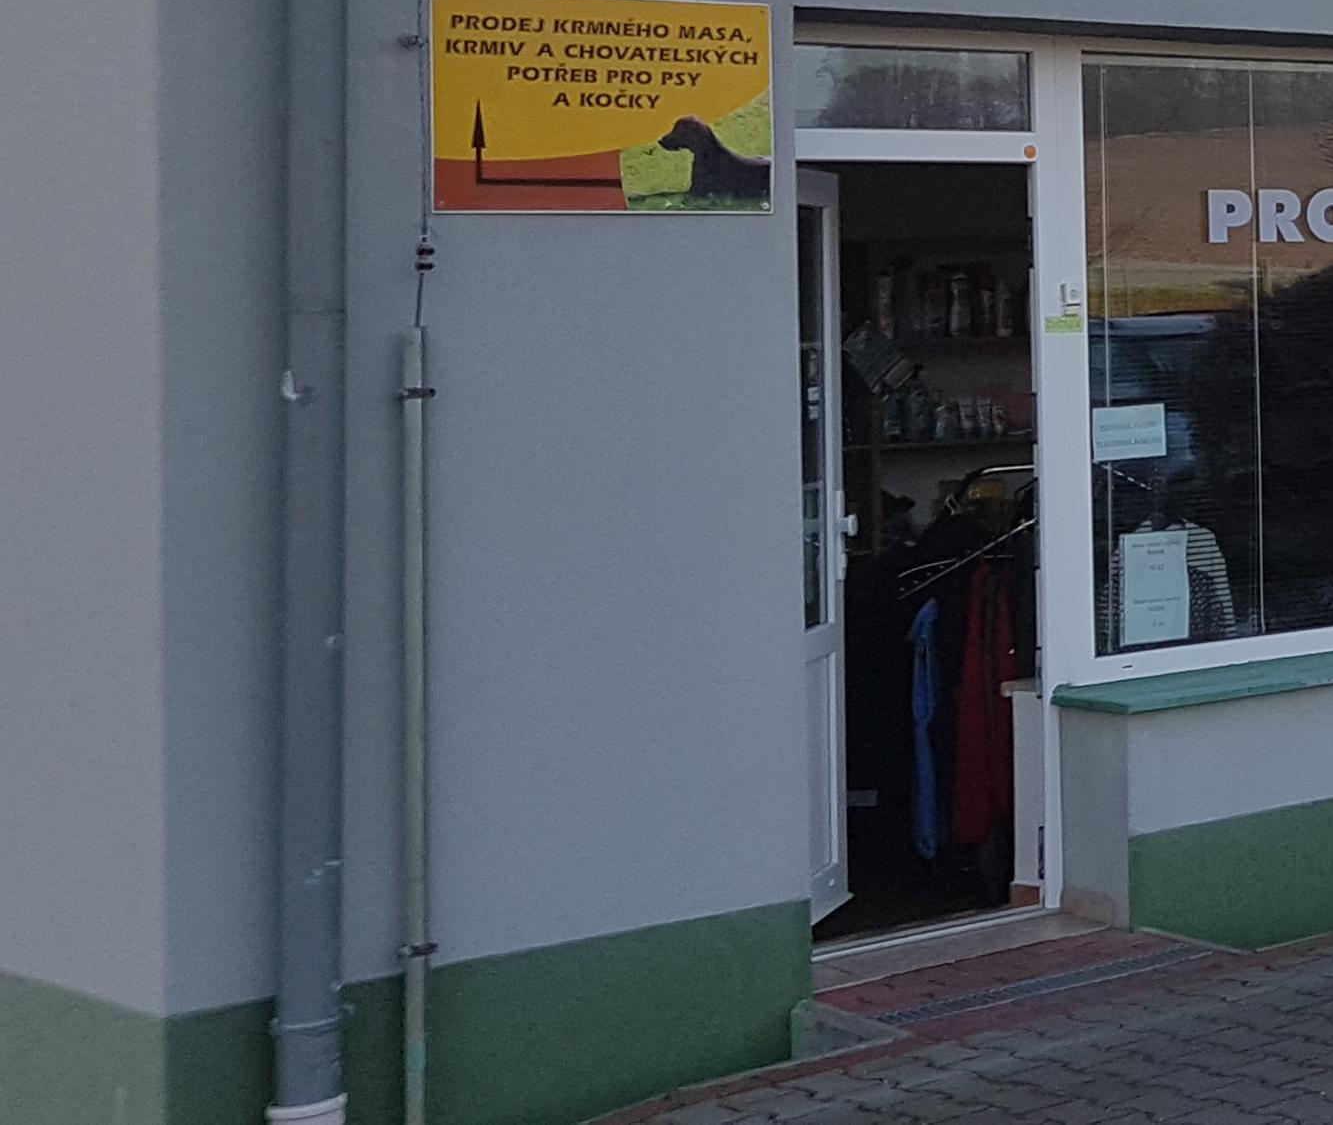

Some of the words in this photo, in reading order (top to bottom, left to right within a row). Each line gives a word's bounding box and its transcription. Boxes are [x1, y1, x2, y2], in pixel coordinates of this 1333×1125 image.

[450, 14, 546, 33] PRODEJ
[552, 17, 670, 39] KRMNÉHO
[678, 25, 753, 44] MASA,
[445, 38, 526, 56] KRMIV
[536, 42, 555, 58] A
[563, 43, 759, 66] CHOVATELSKÝCH
[507, 62, 599, 84] POTŘEB
[606, 69, 653, 85] PRO
[660, 71, 703, 87] PSY
[552, 91, 571, 107] A
[579, 88, 661, 109] KOČKY
